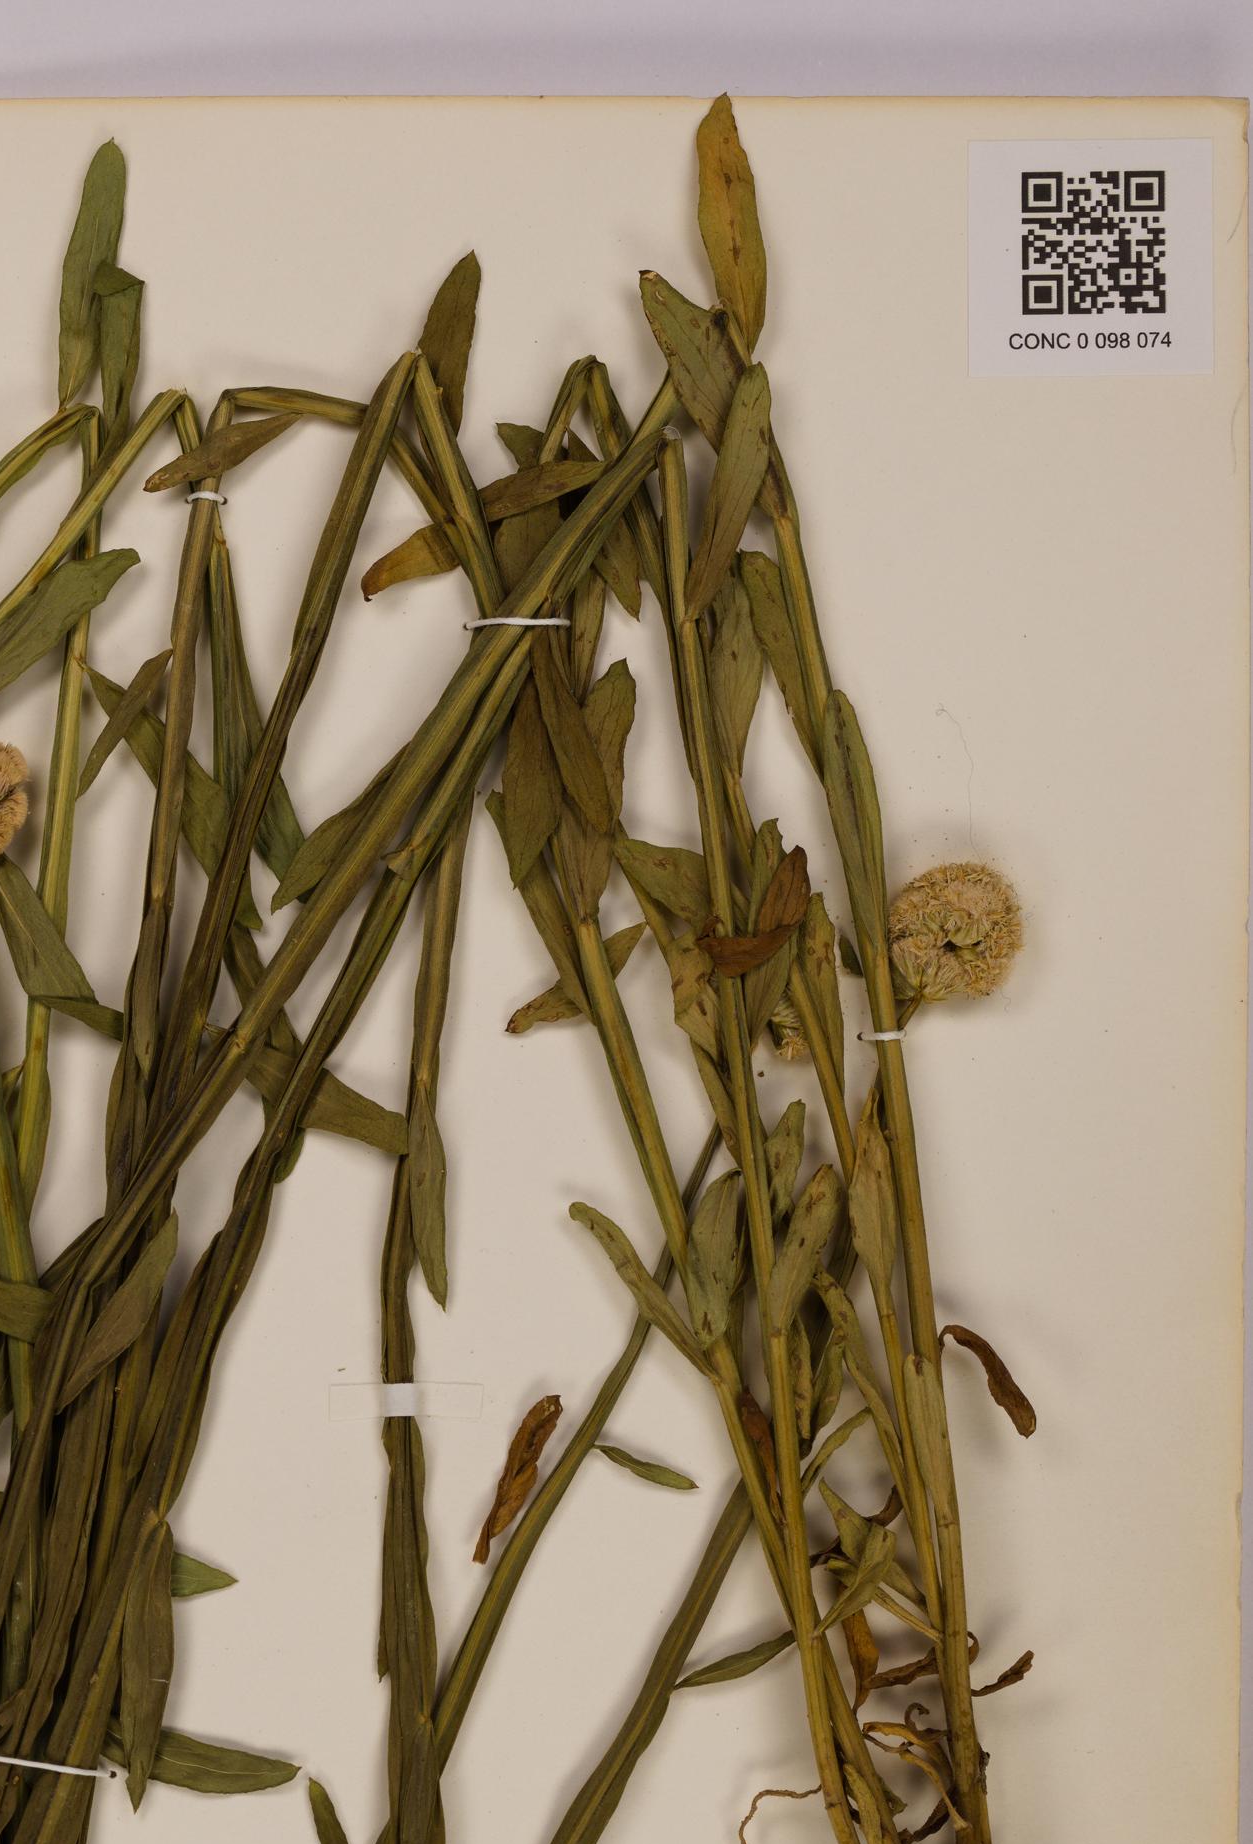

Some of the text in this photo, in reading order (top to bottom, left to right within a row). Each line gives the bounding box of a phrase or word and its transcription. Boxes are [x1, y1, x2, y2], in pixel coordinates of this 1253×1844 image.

[1009, 332, 1171, 349] CONC 0 098 074
